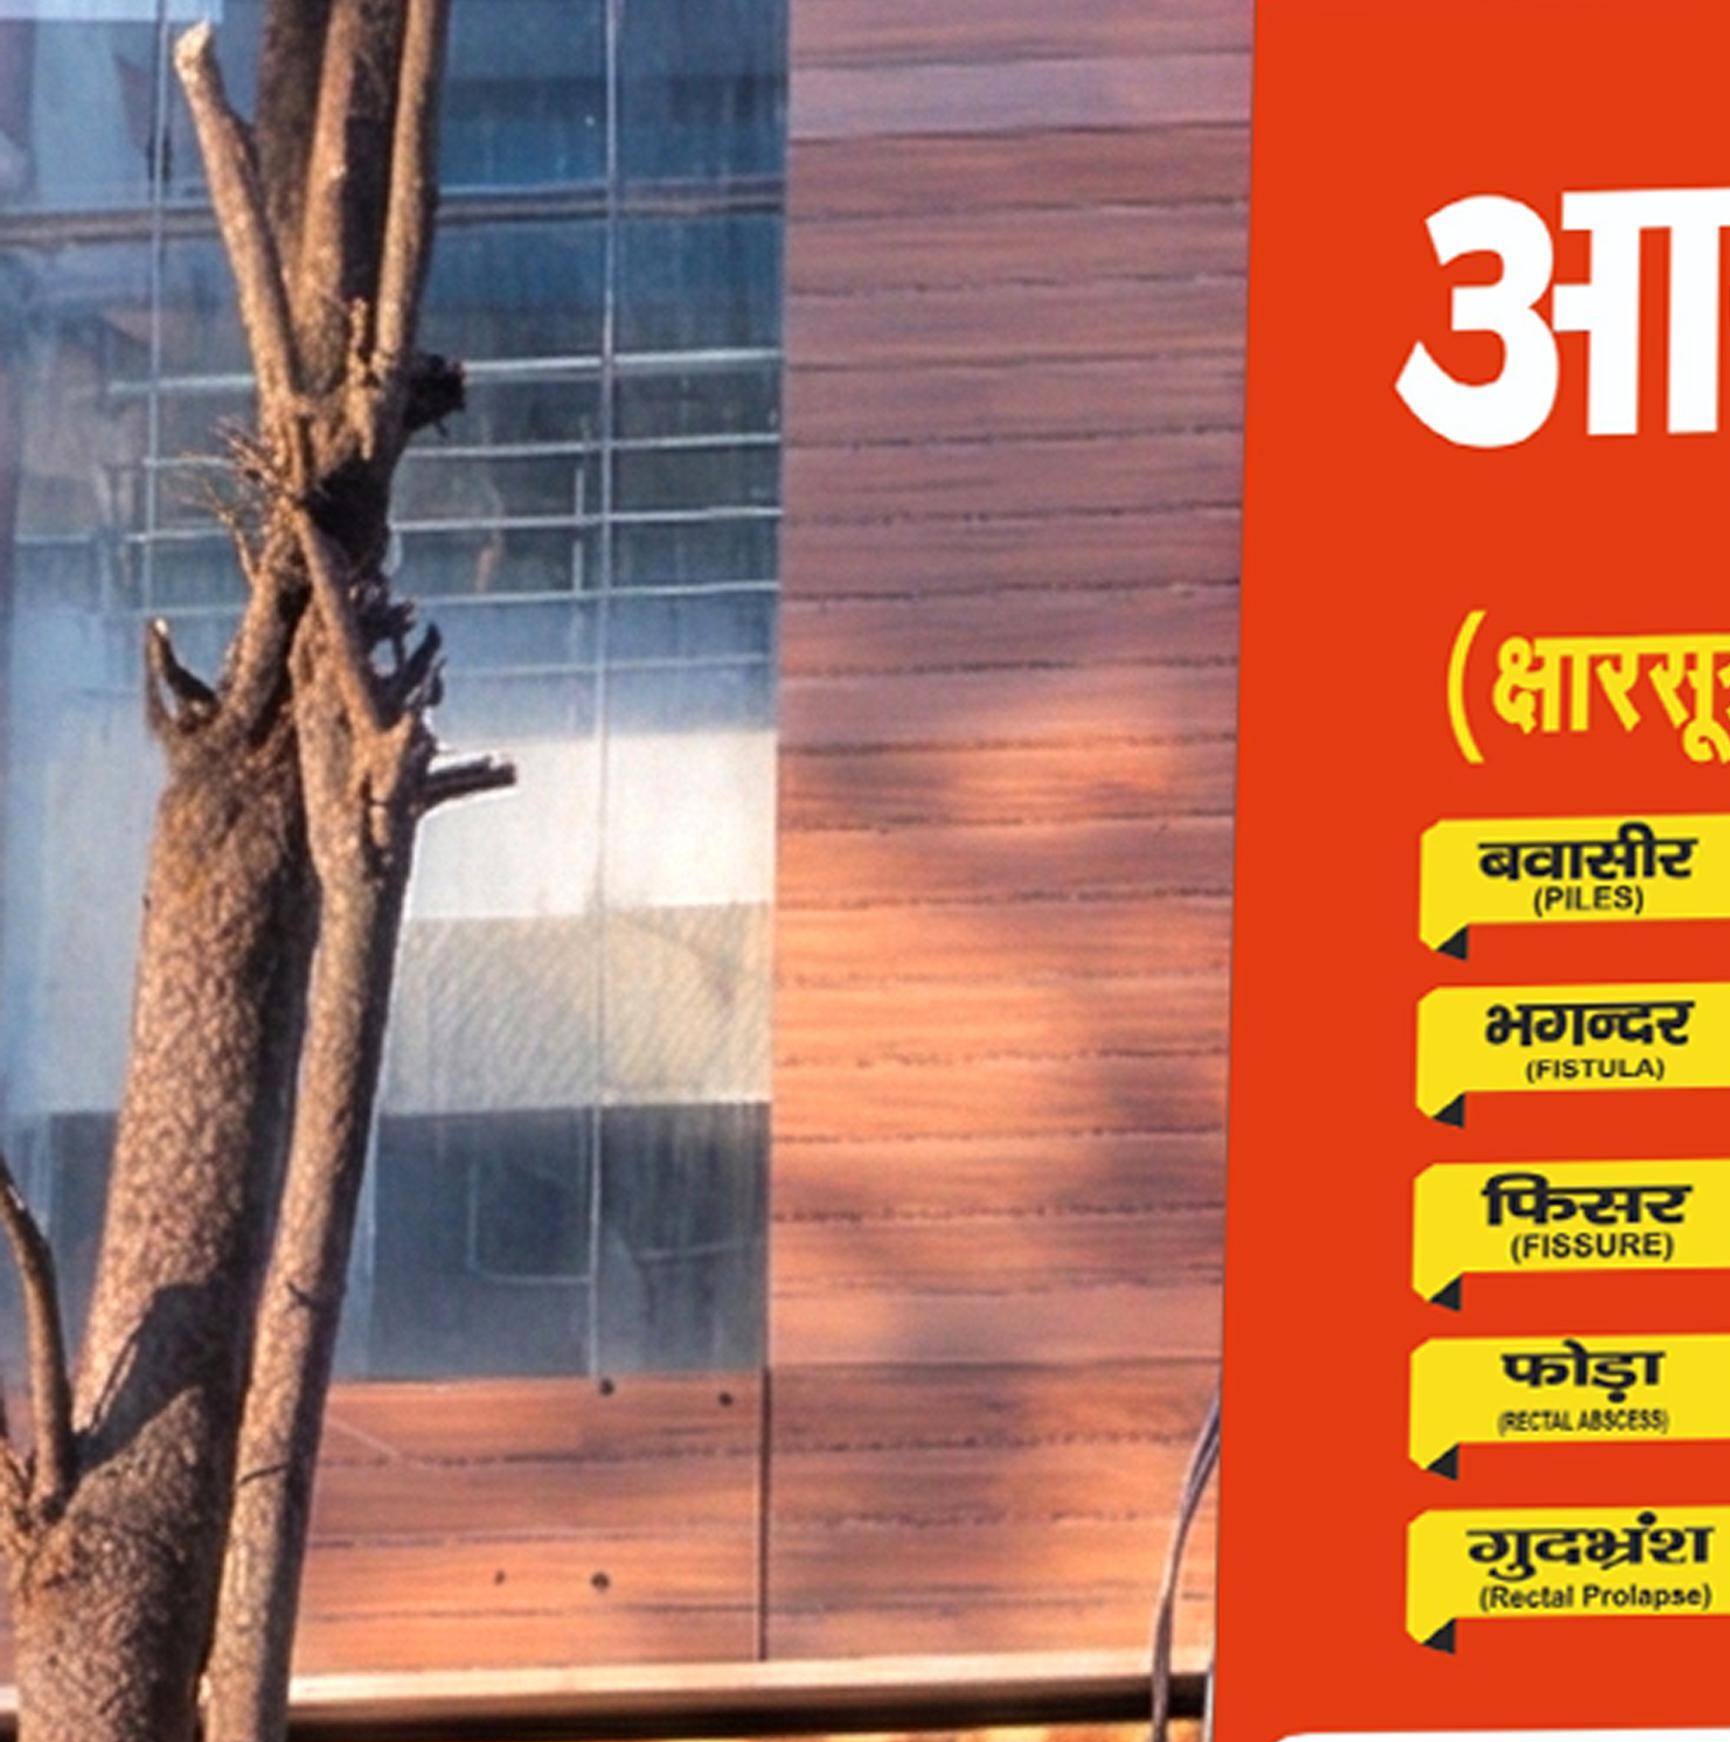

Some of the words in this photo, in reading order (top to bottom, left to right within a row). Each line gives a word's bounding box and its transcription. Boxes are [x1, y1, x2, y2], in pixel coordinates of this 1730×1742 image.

[1478, 822, 1699, 880] बवासीर
[1533, 885, 1645, 917] (PILES)
[1485, 1000, 1695, 1046] भगन्दर
[1525, 1057, 1666, 1083] (FISTULA)
[1480, 1172, 1693, 1227] फिसर
[1510, 1232, 1675, 1264] (FISSURE)
[1501, 1340, 1667, 1404] फोड़ा
[1497, 1411, 1575, 1436] (RECTAL
[1577, 1409, 1670, 1435] ABSCESS)
[1466, 1510, 1716, 1583] गुदभ्रंश
[1478, 1584, 1578, 1614] (Rectal
[1581, 1582, 1713, 1611] Prolapse)
